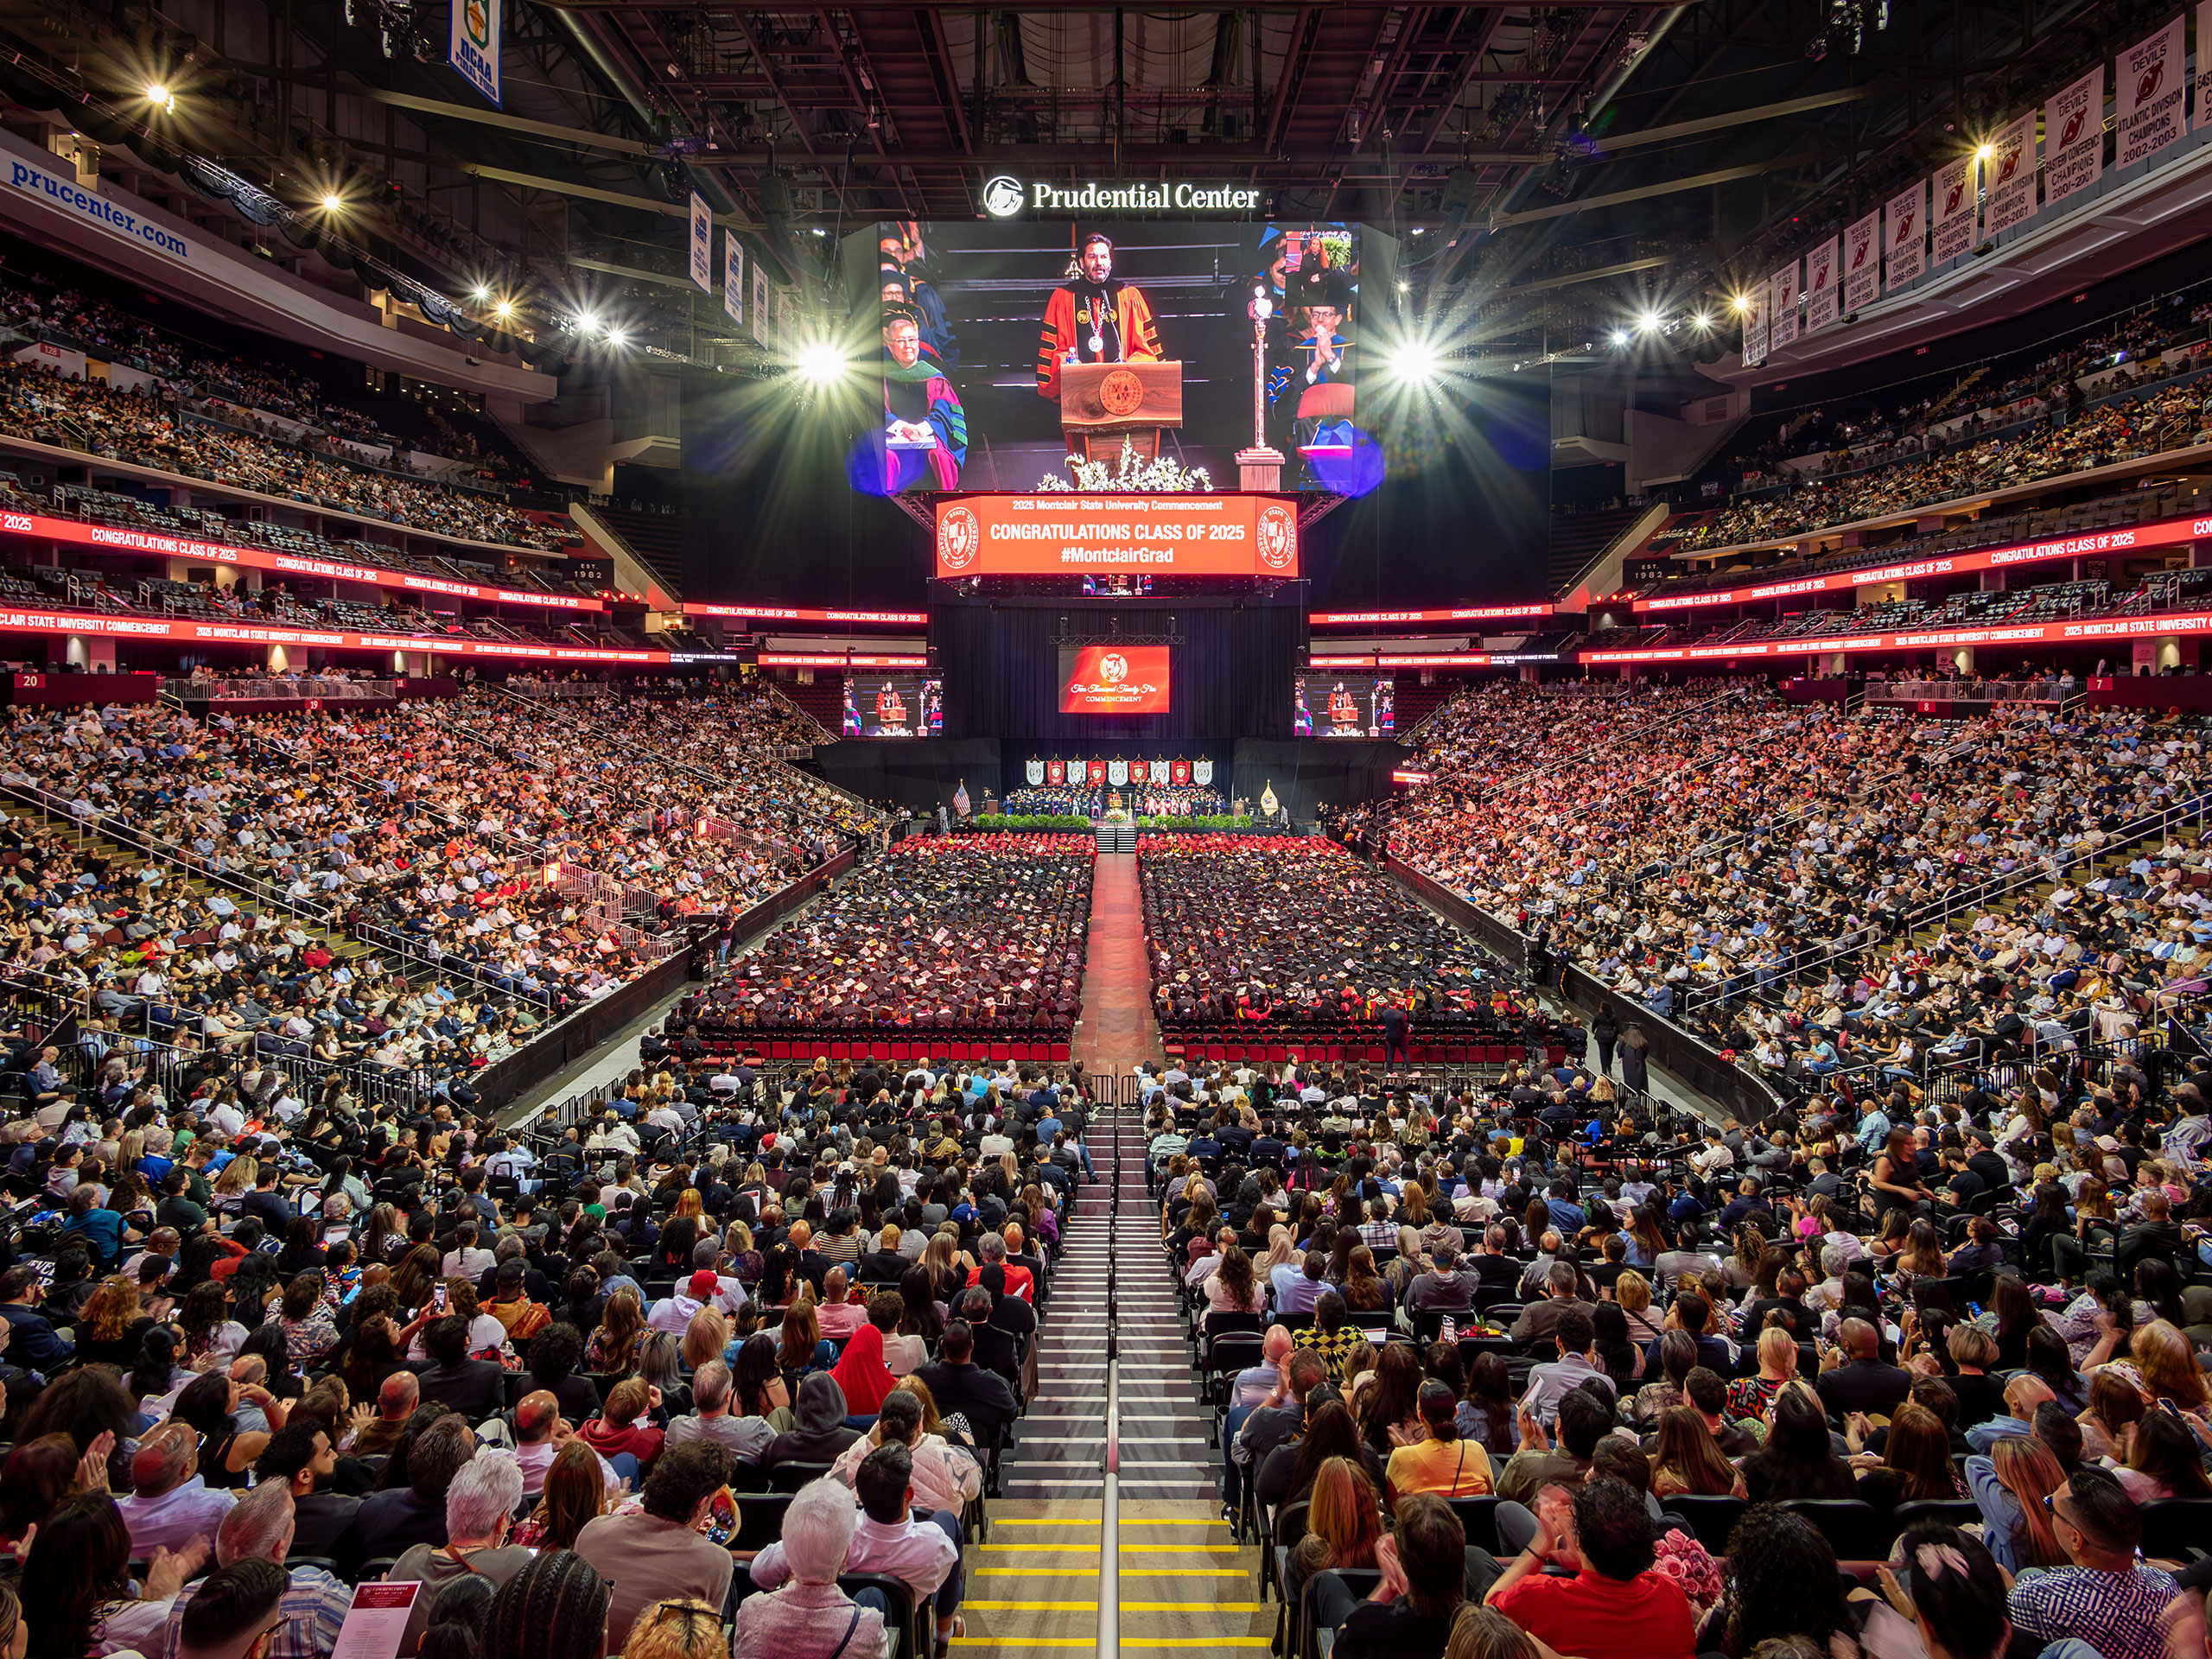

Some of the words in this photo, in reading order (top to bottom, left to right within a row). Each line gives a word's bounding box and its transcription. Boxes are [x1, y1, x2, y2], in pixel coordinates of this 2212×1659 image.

[2130, 49, 2144, 62] NEW
[2145, 31, 2170, 52] JERSEY
[2133, 44, 2167, 73] DEVILS
[2056, 92, 2069, 105] NEW
[2070, 79, 2091, 95] JERSEY
[2059, 91, 2088, 118] DEVILS
[2118, 107, 2150, 134] ATLANTIC
[2152, 87, 2183, 117] DIVISION
[2128, 112, 2171, 145] CHAMPIONS
[1998, 131, 2023, 156] DEVILS
[2123, 127, 2177, 163] 2002-2003
[2045, 151, 2067, 174] EASTERN
[2052, 153, 2094, 187] CHAMPIONS
[1943, 168, 1966, 188] DEVILS
[1033, 183, 1171, 209] Prudential
[1175, 183, 1259, 209] Center
[1985, 186, 2010, 208] ATLANTIC
[2011, 172, 2034, 194] DIVISION
[11, 161, 188, 257] prucenter.com
[1895, 199, 1916, 218] DEVILS
[1993, 193, 2025, 219] CHAMPIONS
[1991, 206, 2029, 233] 2000-2001
[1853, 226, 1871, 244] DEVILS
[1938, 223, 1970, 250] CHAMPIONS
[1938, 238, 1969, 261] 1999-2000
[1893, 253, 1917, 273] CHAMPIONS
[1013, 500, 1034, 510] 2025
[1037, 500, 1078, 510] Montclair
[1080, 500, 1103, 510] State
[1105, 500, 1149, 512] University
[1151, 500, 1223, 511] Commencement
[4, 516, 32, 531] 2025
[990, 524, 1130, 540] CONGRATULATIONS
[1135, 524, 1182, 540] CLASS
[1186, 524, 1206, 540] OF
[1209, 524, 1244, 540] 2025
[92, 528, 177, 552] CONGRATULATIONS
[179, 541, 205, 556] CLASS
[207, 544, 217, 558] OF
[218, 547, 238, 561] 2025
[1061, 546, 1173, 563] #MontclairGrad
[1991, 541, 2065, 564] CONGRATULATIONS
[2067, 538, 2095, 554] CLASS
[2097, 537, 2109, 550] OF
[2111, 532, 2134, 547] 2025
[276, 556, 334, 575] CONGRATULATIONS
[336, 566, 354, 577] CLASS
[355, 569, 363, 579] OF
[364, 569, 377, 581] 2025
[574, 570, 602, 579] 1982
[1853, 566, 1904, 583] CONGRATULATIONS
[1905, 564, 1925, 576] CLASS
[1927, 563, 1936, 574] OF
[1936, 560, 1952, 572] 2025
[404, 577, 448, 591] CONGRATULATIONS
[448, 583, 461, 594] CLASS
[462, 586, 467, 594] OF
[468, 587, 478, 596] 2025
[1752, 583, 1790, 597] CONGRATULATIONS
[1791, 582, 1805, 593] CLASS
[1806, 581, 1813, 590] OF
[1814, 580, 1825, 589] 2025
[543, 596, 559, 605] CLASS
[1694, 595, 1711, 605] CLASS
[1712, 594, 1719, 603] OF
[707, 607, 756, 615] CONGRATULATIONS
[757, 608, 774, 617] CLASS
[827, 612, 879, 620] CONGRATULATIONS
[1328, 613, 1380, 622] CONGRATULATIONS
[1452, 608, 1503, 618] CONGRATULATIONS
[28, 614, 54, 627] STATE
[57, 617, 105, 631] UNIVERSITY
[106, 620, 170, 634] COMMENCEMENT
[2064, 626, 2082, 636] 2025
[2084, 622, 2127, 635] MONTCLAIR
[2129, 620, 2155, 632] STATE
[2156, 617, 2208, 631] UNIVERSITY
[196, 626, 213, 637] 2025
[213, 627, 249, 639] MONTCLAIR
[251, 630, 268, 639] STATE
[269, 631, 300, 642] UNIVERSITY
[301, 632, 343, 645] COMMENCEMENT
[1895, 635, 1908, 646] 2025
[1908, 634, 1938, 645] MONTCLAIR
[1939, 632, 1955, 643] STATE
[1956, 631, 1989, 642] UNIVERSITY
[1990, 628, 2044, 640] COMMENCEMENT
[23, 676, 37, 687] 20
[2096, 679, 2103, 689] 7
[310, 701, 318, 709] 19
[1924, 702, 1929, 711] 8
